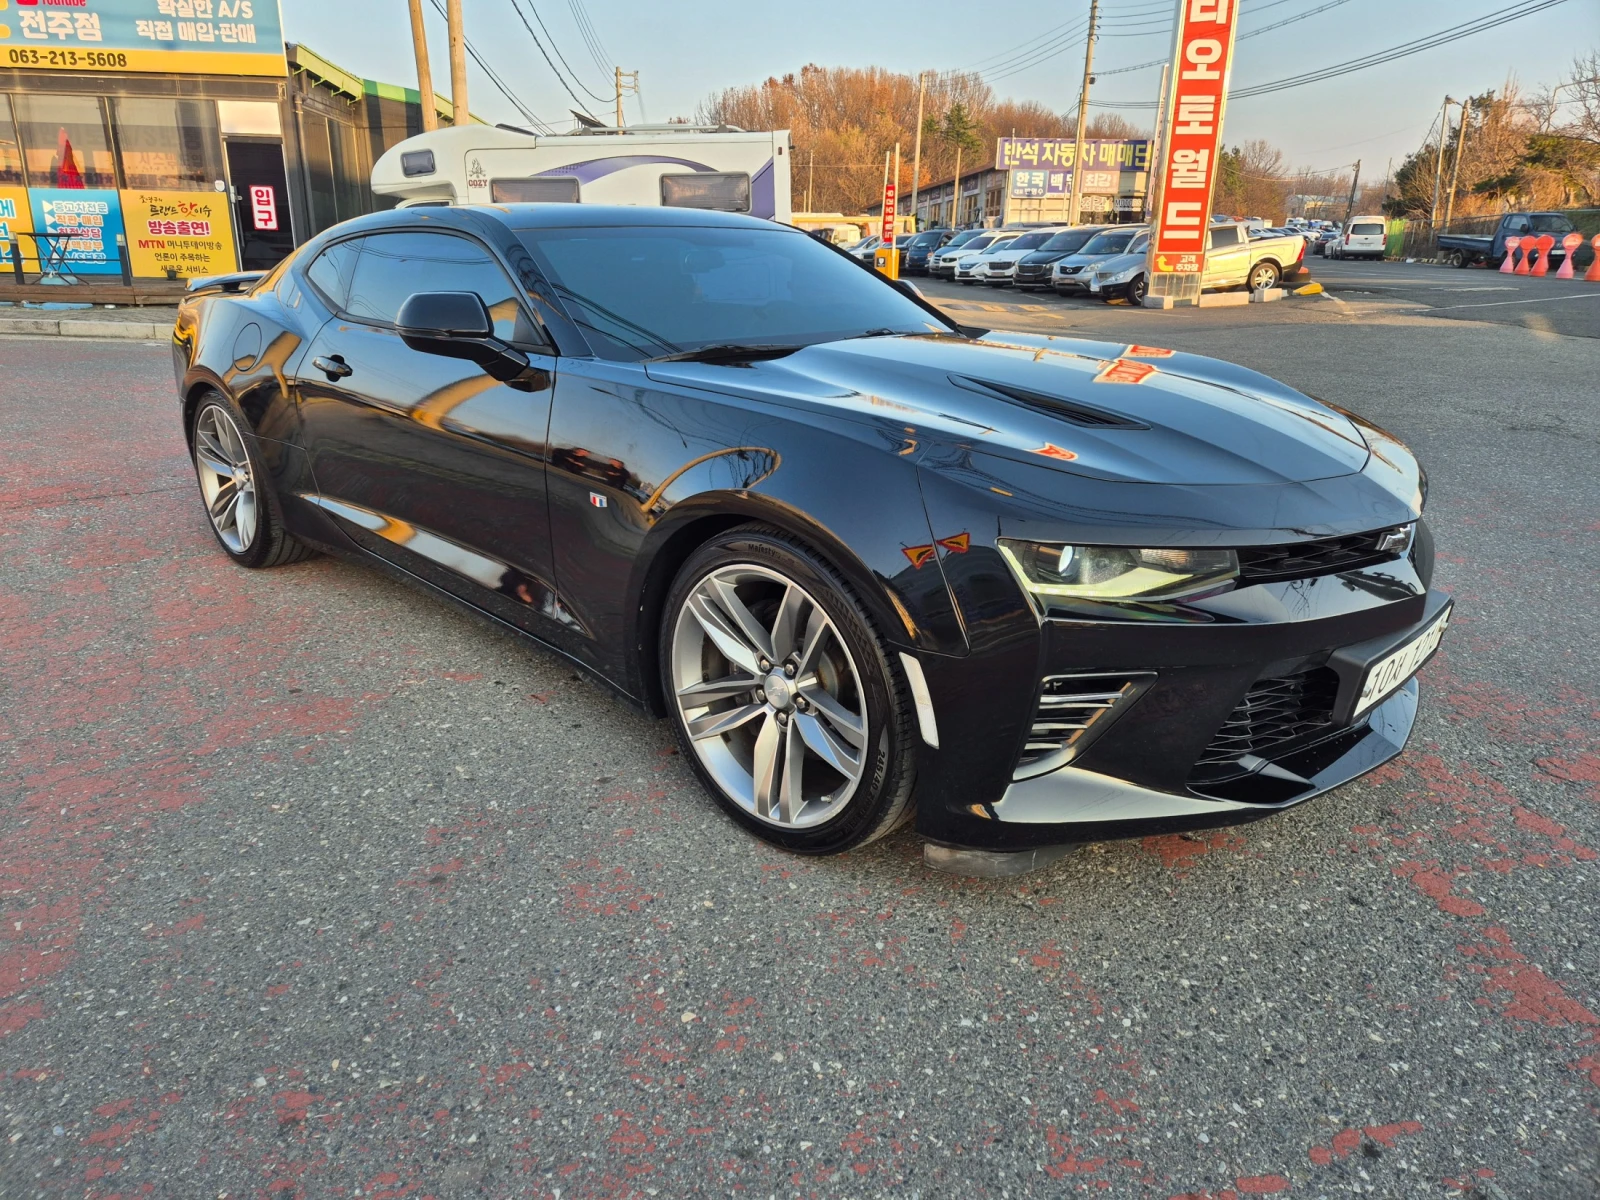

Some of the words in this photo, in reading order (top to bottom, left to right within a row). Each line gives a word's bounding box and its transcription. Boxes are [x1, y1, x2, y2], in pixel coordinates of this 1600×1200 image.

[157, 0, 213, 18] 확실한
[218, 0, 254, 19] A/S
[18, 10, 103, 42] 전주점
[135, 20, 174, 41] 직접
[177, 21, 256, 44] 매입·판매
[9, 49, 128, 68] 063-213-5608
[1003, 143, 1038, 166] 반석
[1016, 172, 1044, 187] 한국
[53, 201, 108, 214] 중고차전문
[255, 188, 274, 226] 입구
[148, 220, 210, 236] 방송출연!
[138, 240, 165, 249] MTN
[154, 253, 178, 261] 언론이
[180, 253, 210, 262] 주목하는
[1180, 255, 1196, 263] 고객
[186, 265, 209, 274] 서비스
[1176, 263, 1199, 271] 주차장
[748, 543, 776, 557] Majesty
[870, 750, 886, 792] 245/40
